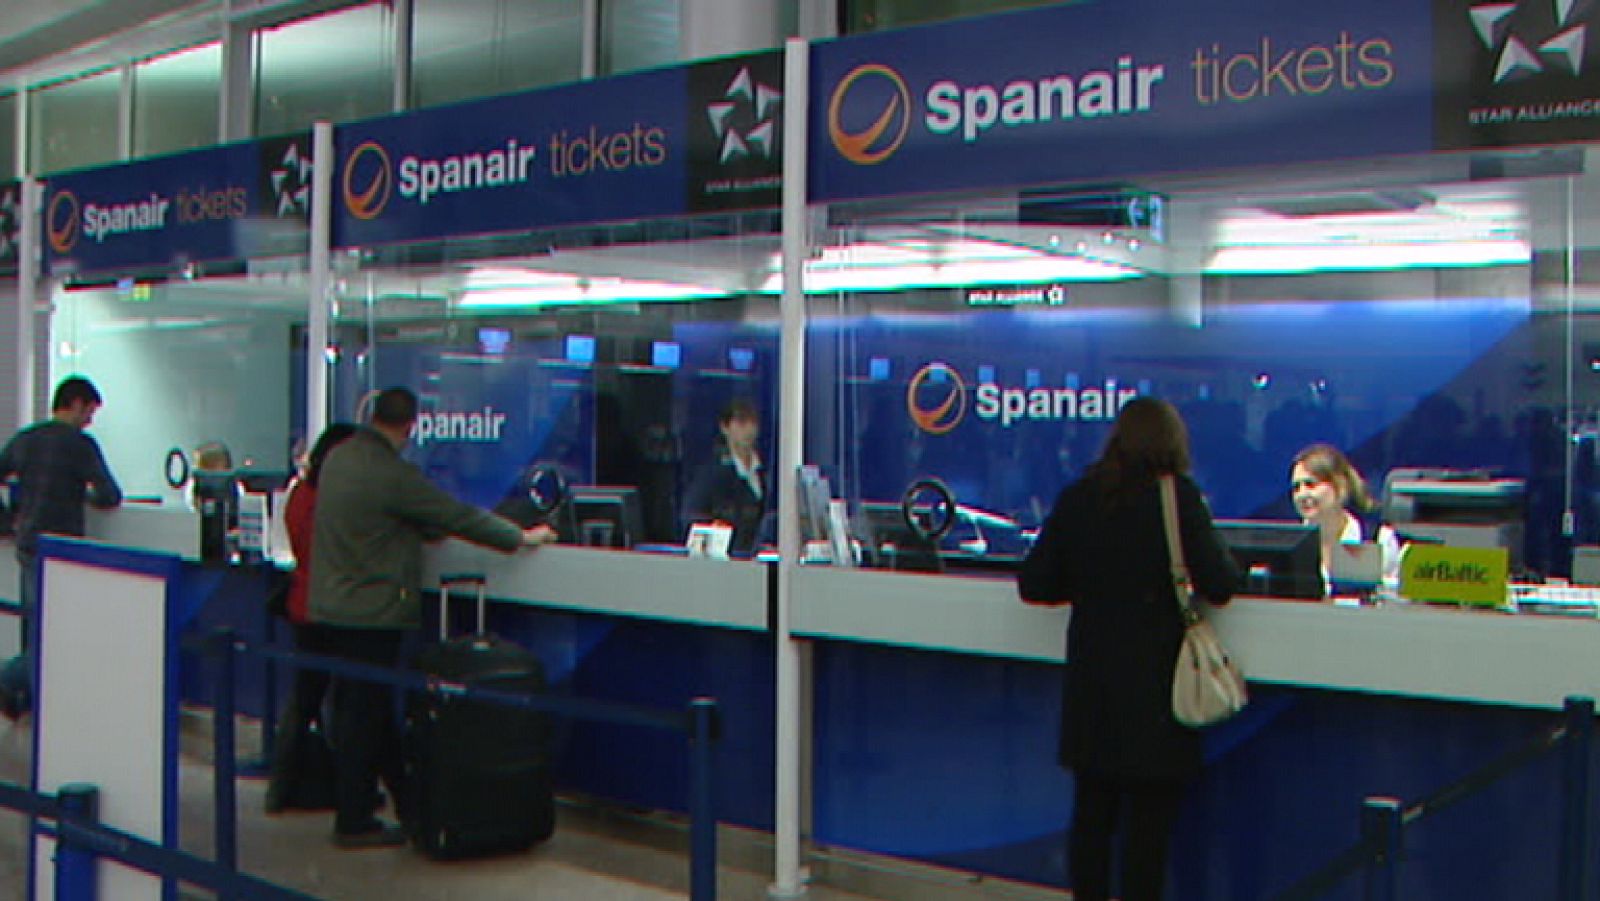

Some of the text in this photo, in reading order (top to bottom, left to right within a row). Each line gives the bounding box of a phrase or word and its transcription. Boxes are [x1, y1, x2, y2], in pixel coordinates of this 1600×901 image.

[925, 31, 1395, 143] Spanair tickets
[1468, 107, 1514, 124] STAR
[398, 122, 667, 203] Spanair tickets
[83, 185, 247, 242] Spanair tickets
